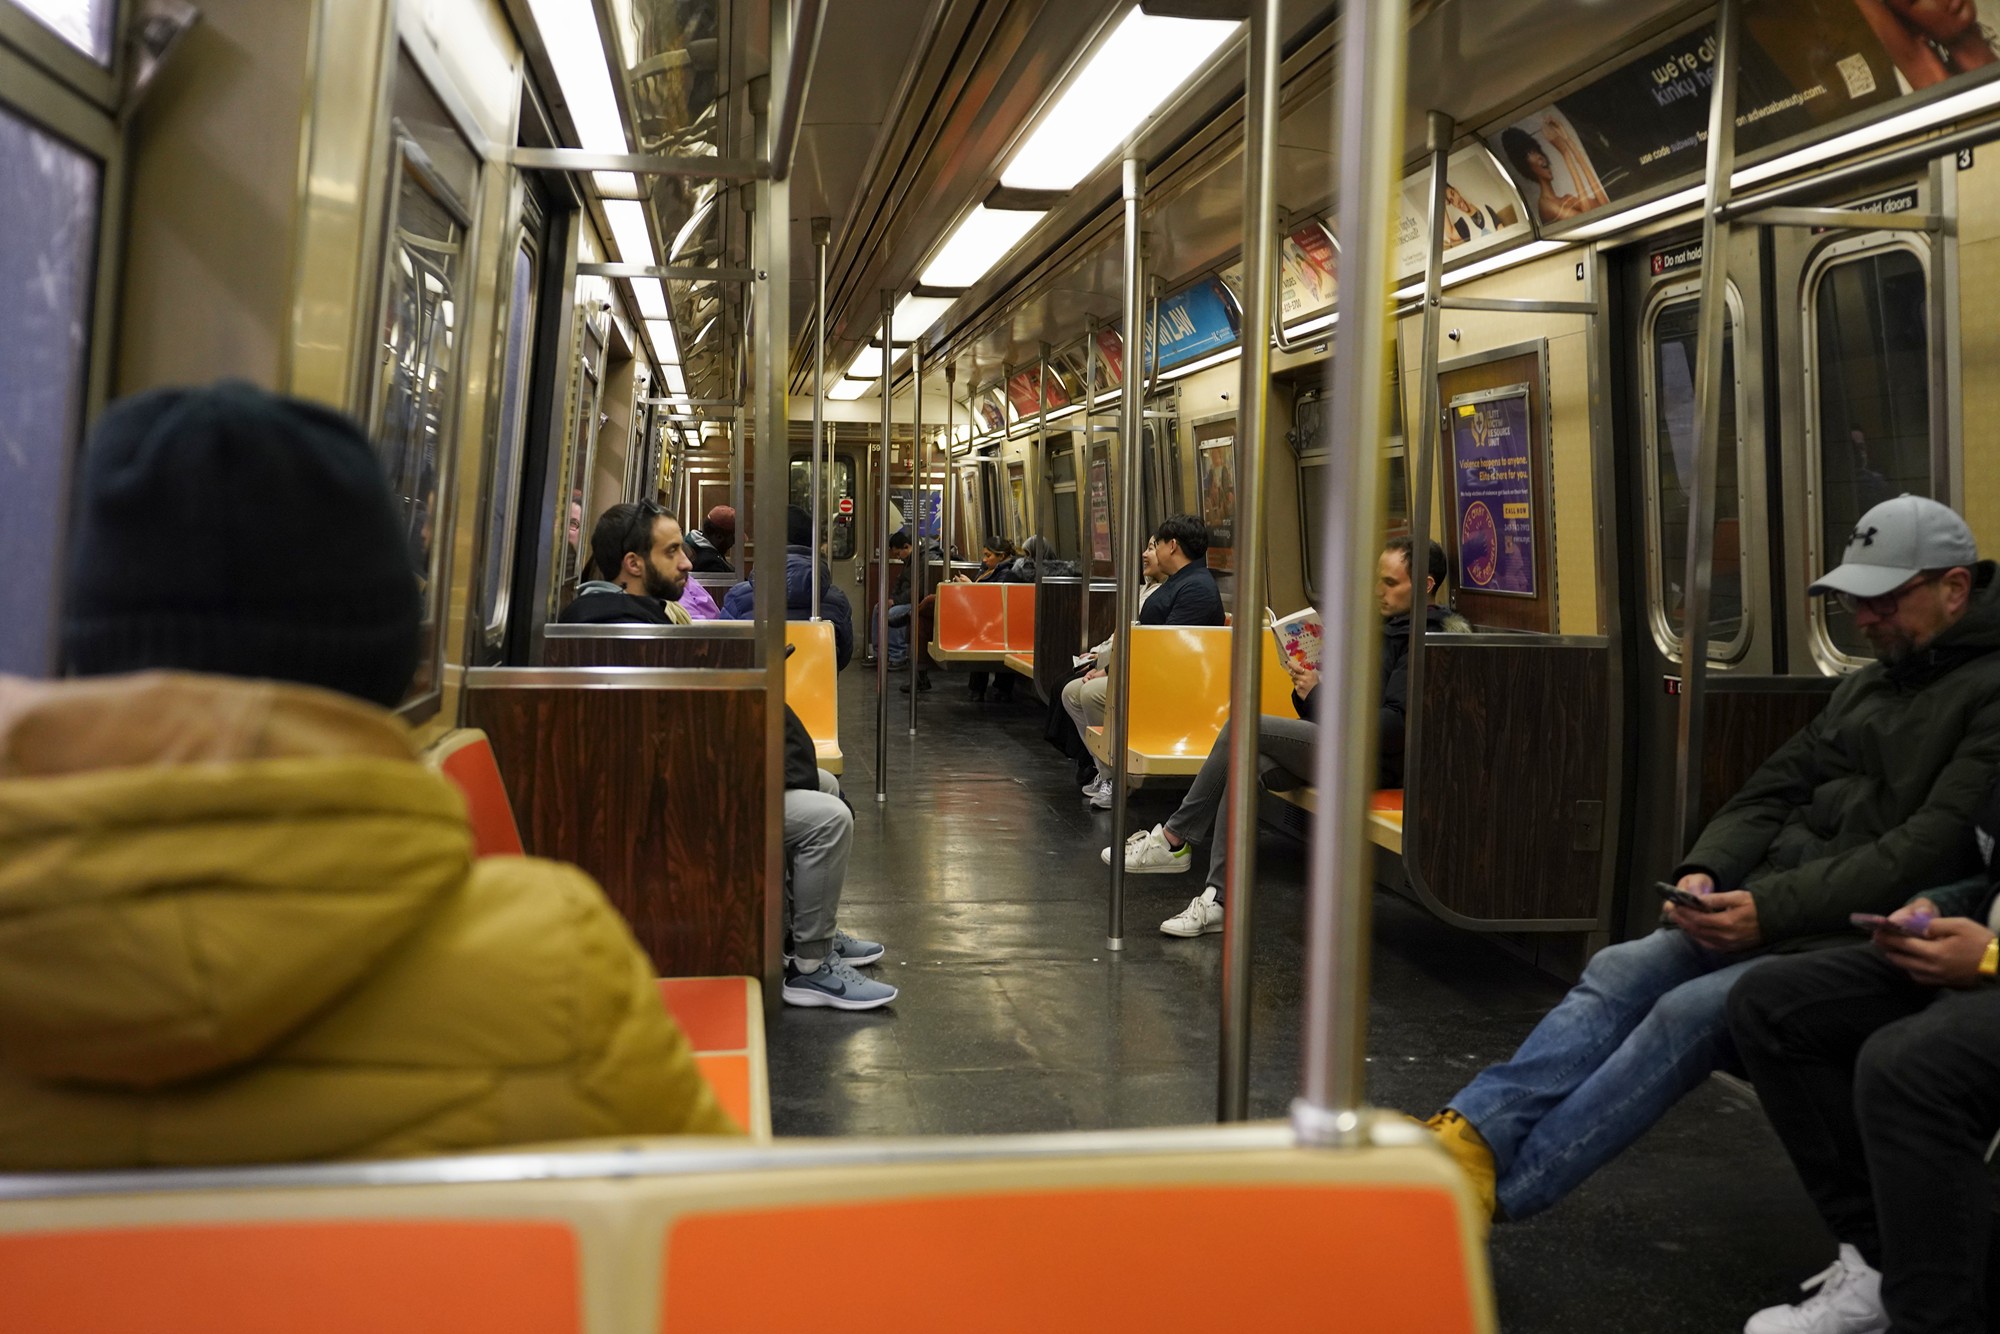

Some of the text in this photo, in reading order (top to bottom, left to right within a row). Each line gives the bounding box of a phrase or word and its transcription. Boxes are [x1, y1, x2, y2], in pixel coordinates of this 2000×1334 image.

[1651, 53, 1698, 84] we're
[1651, 77, 1698, 106] kinky
[1639, 152, 1653, 165] use
[1652, 145, 1671, 160] code
[1959, 149, 1971, 168] 3
[1883, 196, 1912, 214] doors
[1664, 246, 1702, 267] Do not hold
[1161, 305, 1197, 341] LAW
[1459, 459, 1480, 469] Violence
[1480, 458, 1501, 469] happens
[1508, 469, 1516, 479] for
